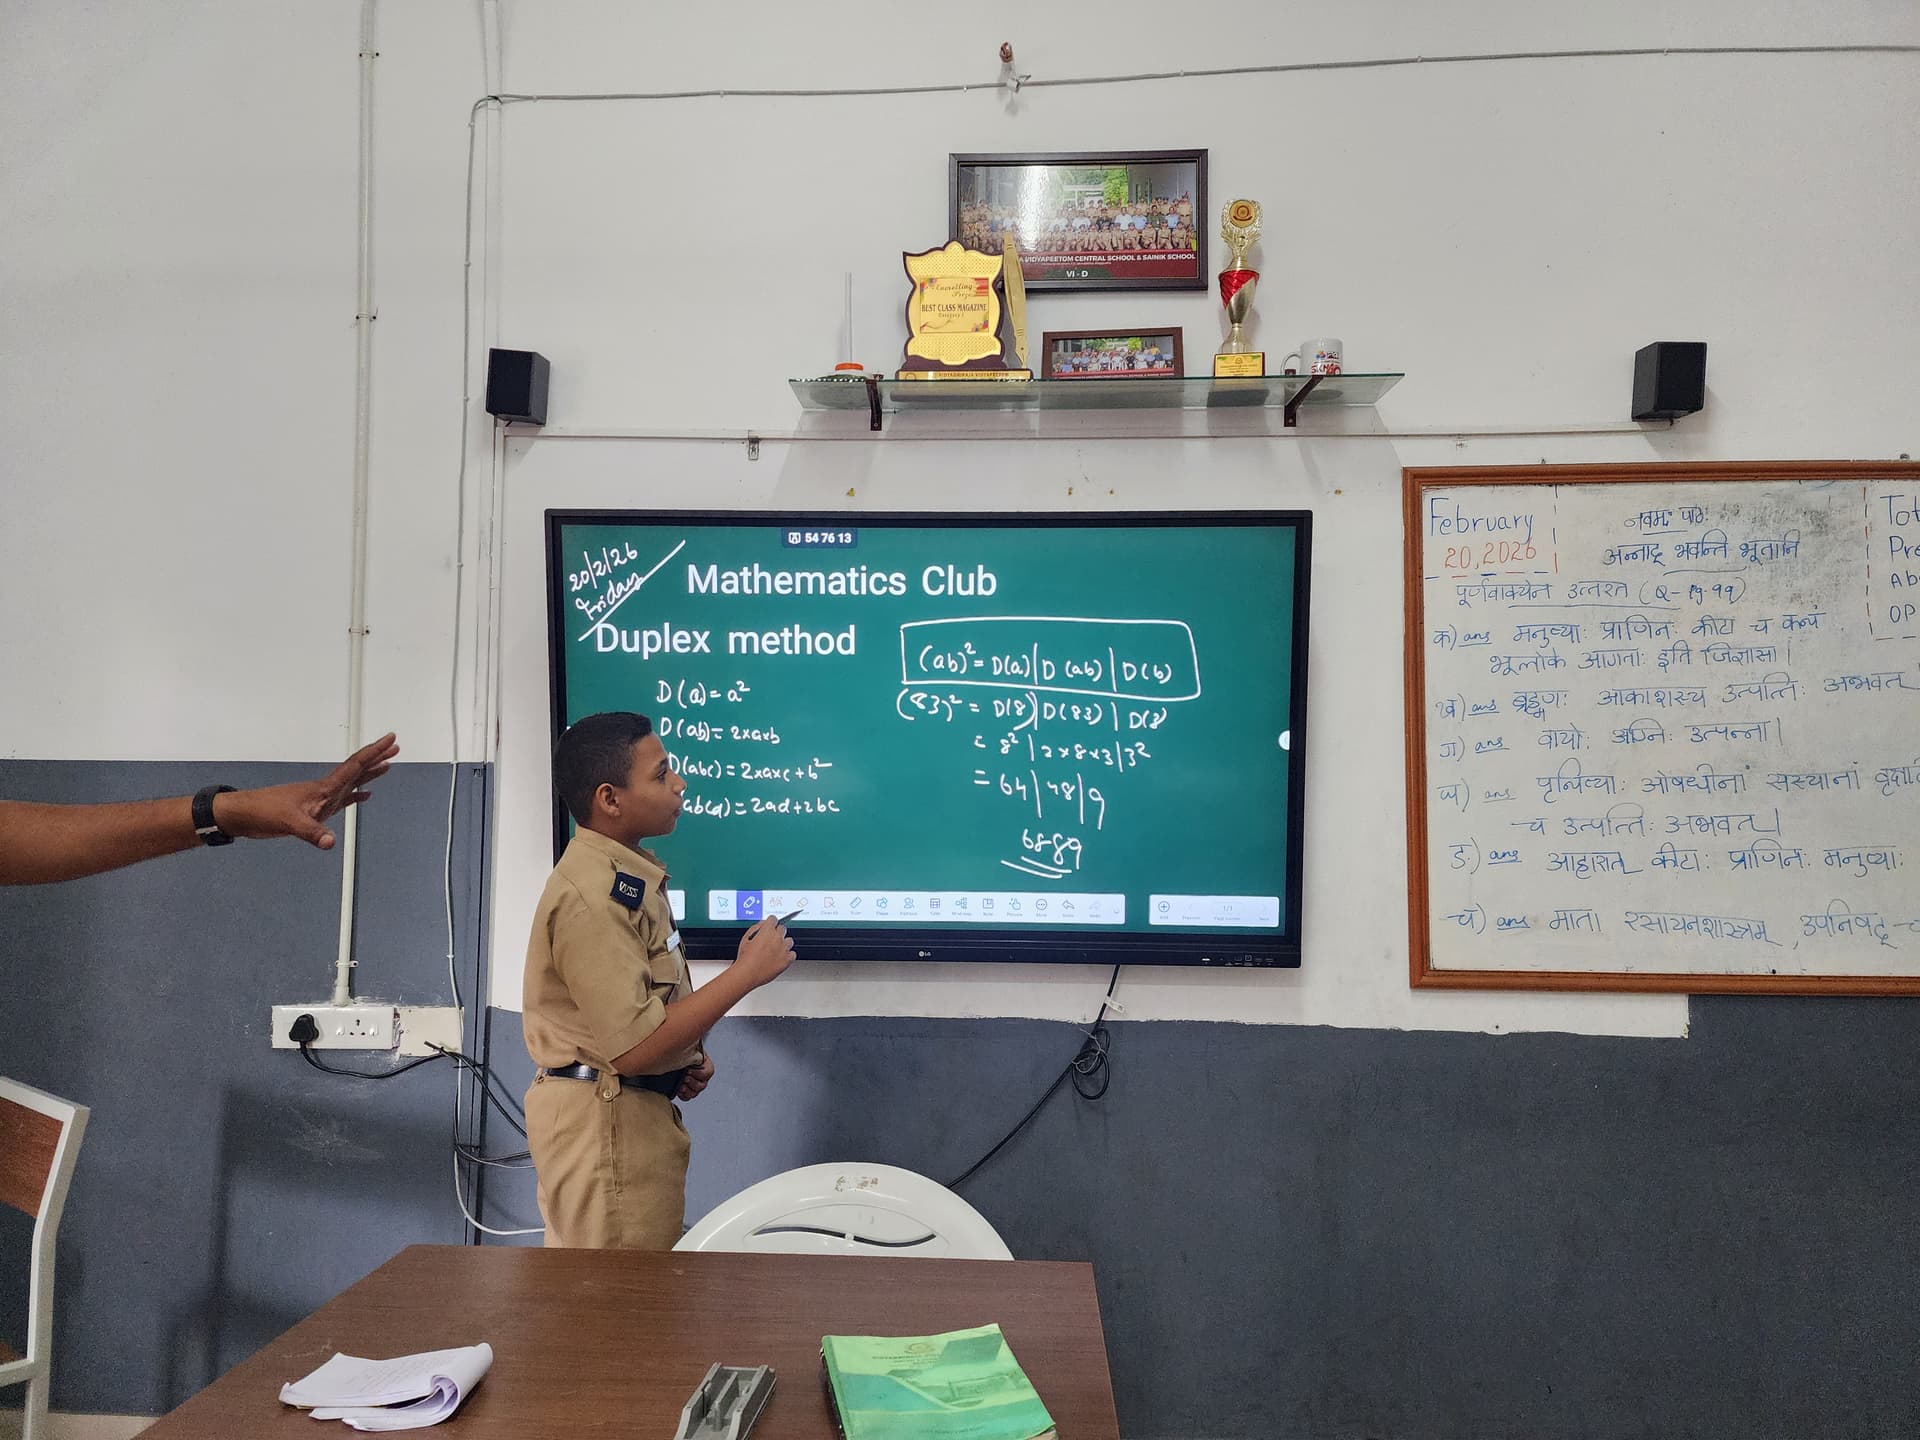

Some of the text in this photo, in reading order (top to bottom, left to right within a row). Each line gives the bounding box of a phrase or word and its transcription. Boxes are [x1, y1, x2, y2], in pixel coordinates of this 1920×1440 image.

[922, 303, 987, 312] BEST CLASS MAGAZINE
[1430, 498, 1534, 545] February
[805, 532, 852, 543] 54 76 13
[569, 542, 637, 592] 20/2/26
[687, 564, 997, 596] Mathematics Club
[596, 622, 855, 660] Duplex method
[1461, 631, 1491, 644] ans
[1750, 618, 1773, 634] च
[1475, 736, 1505, 751] ans
[1549, 908, 1601, 932] माता
